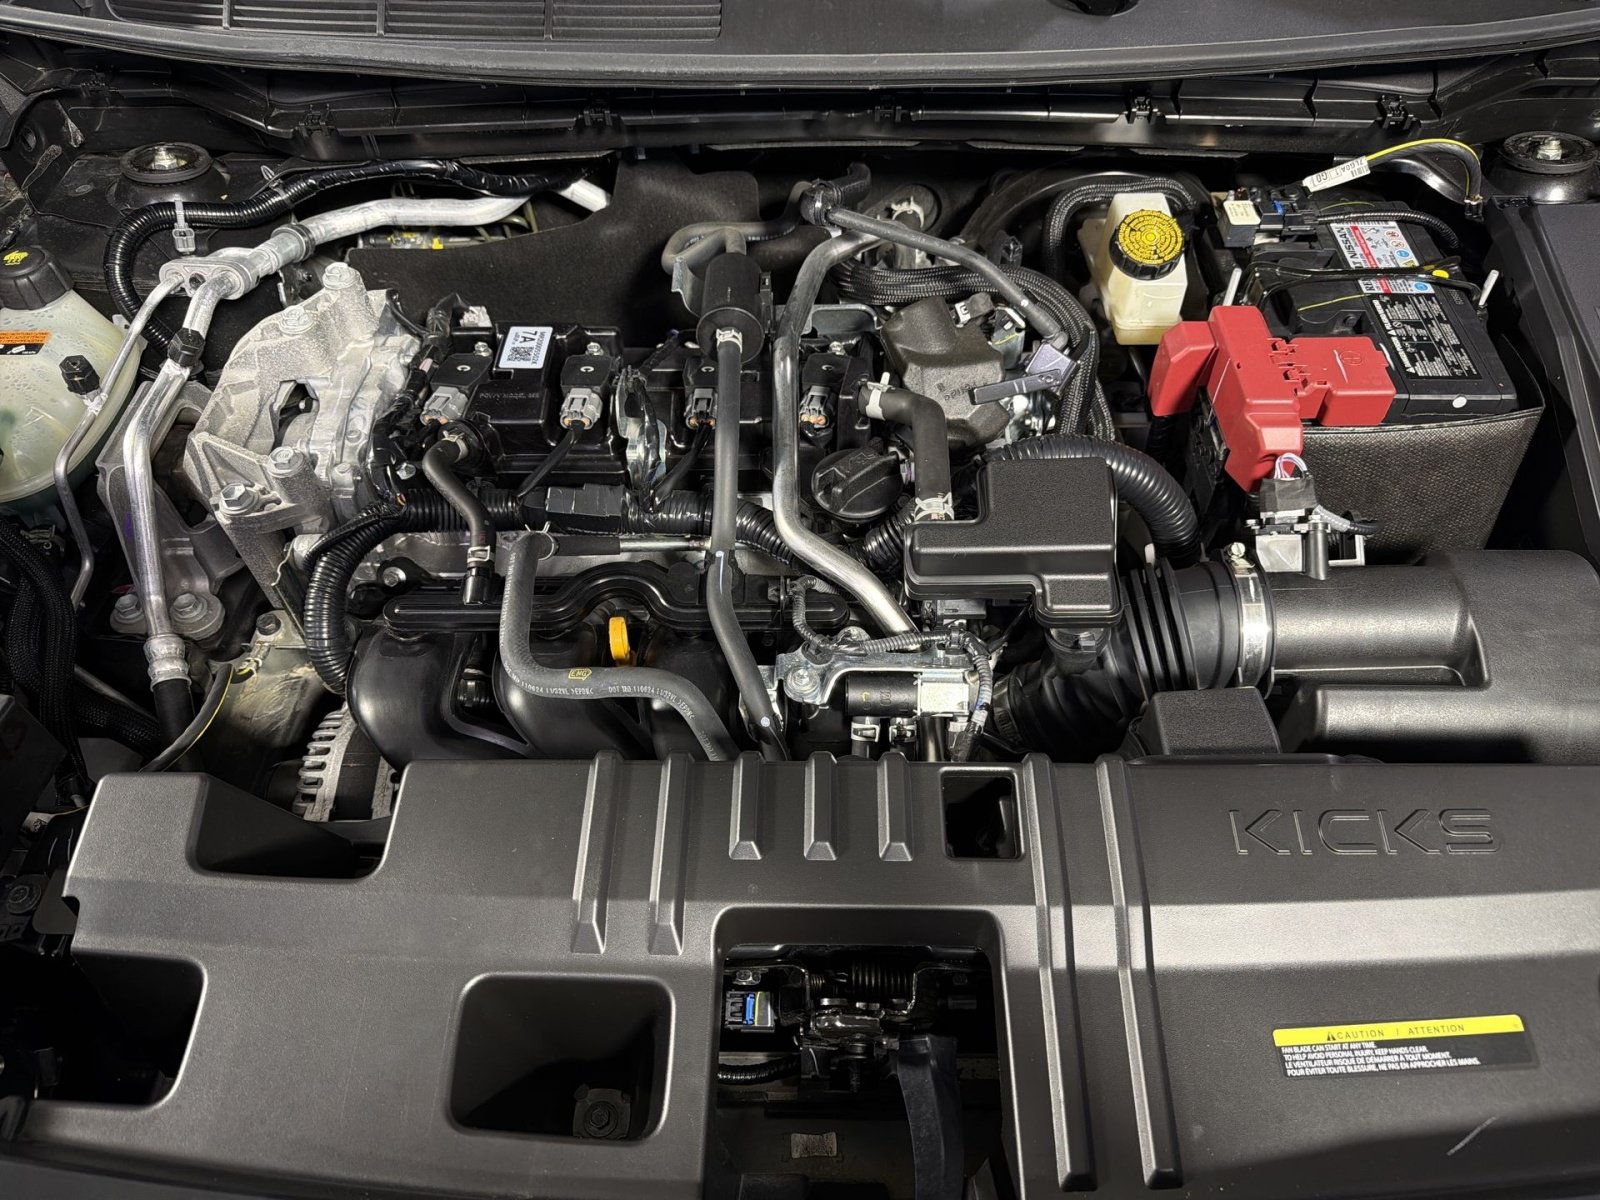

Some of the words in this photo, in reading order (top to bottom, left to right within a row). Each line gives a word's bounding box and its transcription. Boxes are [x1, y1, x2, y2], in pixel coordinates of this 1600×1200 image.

[1337, 227, 1359, 259] NISSAN
[519, 331, 538, 343] 7A
[1228, 808, 1498, 855] KICKS
[1337, 1029, 1385, 1039] CAUTION
[1408, 1024, 1465, 1035] ATTENTION
[1292, 1053, 1306, 1061] HELP
[1325, 1050, 1354, 1059] PERSONAL
[1293, 1045, 1311, 1053] BLADE
[1311, 1044, 1324, 1052] CAN
[1325, 1043, 1341, 1051] START
[1284, 1061, 1293, 1069] LE
[1293, 1059, 1333, 1068] VENTILATEUR
[1334, 1057, 1356, 1066] RISQUE
[1405, 1053, 1421, 1061] TOUT
[1287, 1068, 1305, 1076] POUR
[1326, 1066, 1346, 1074] TOUTE
[1409, 1059, 1447, 1068] APPROCHER
[1447, 1058, 1458, 1066] LES
